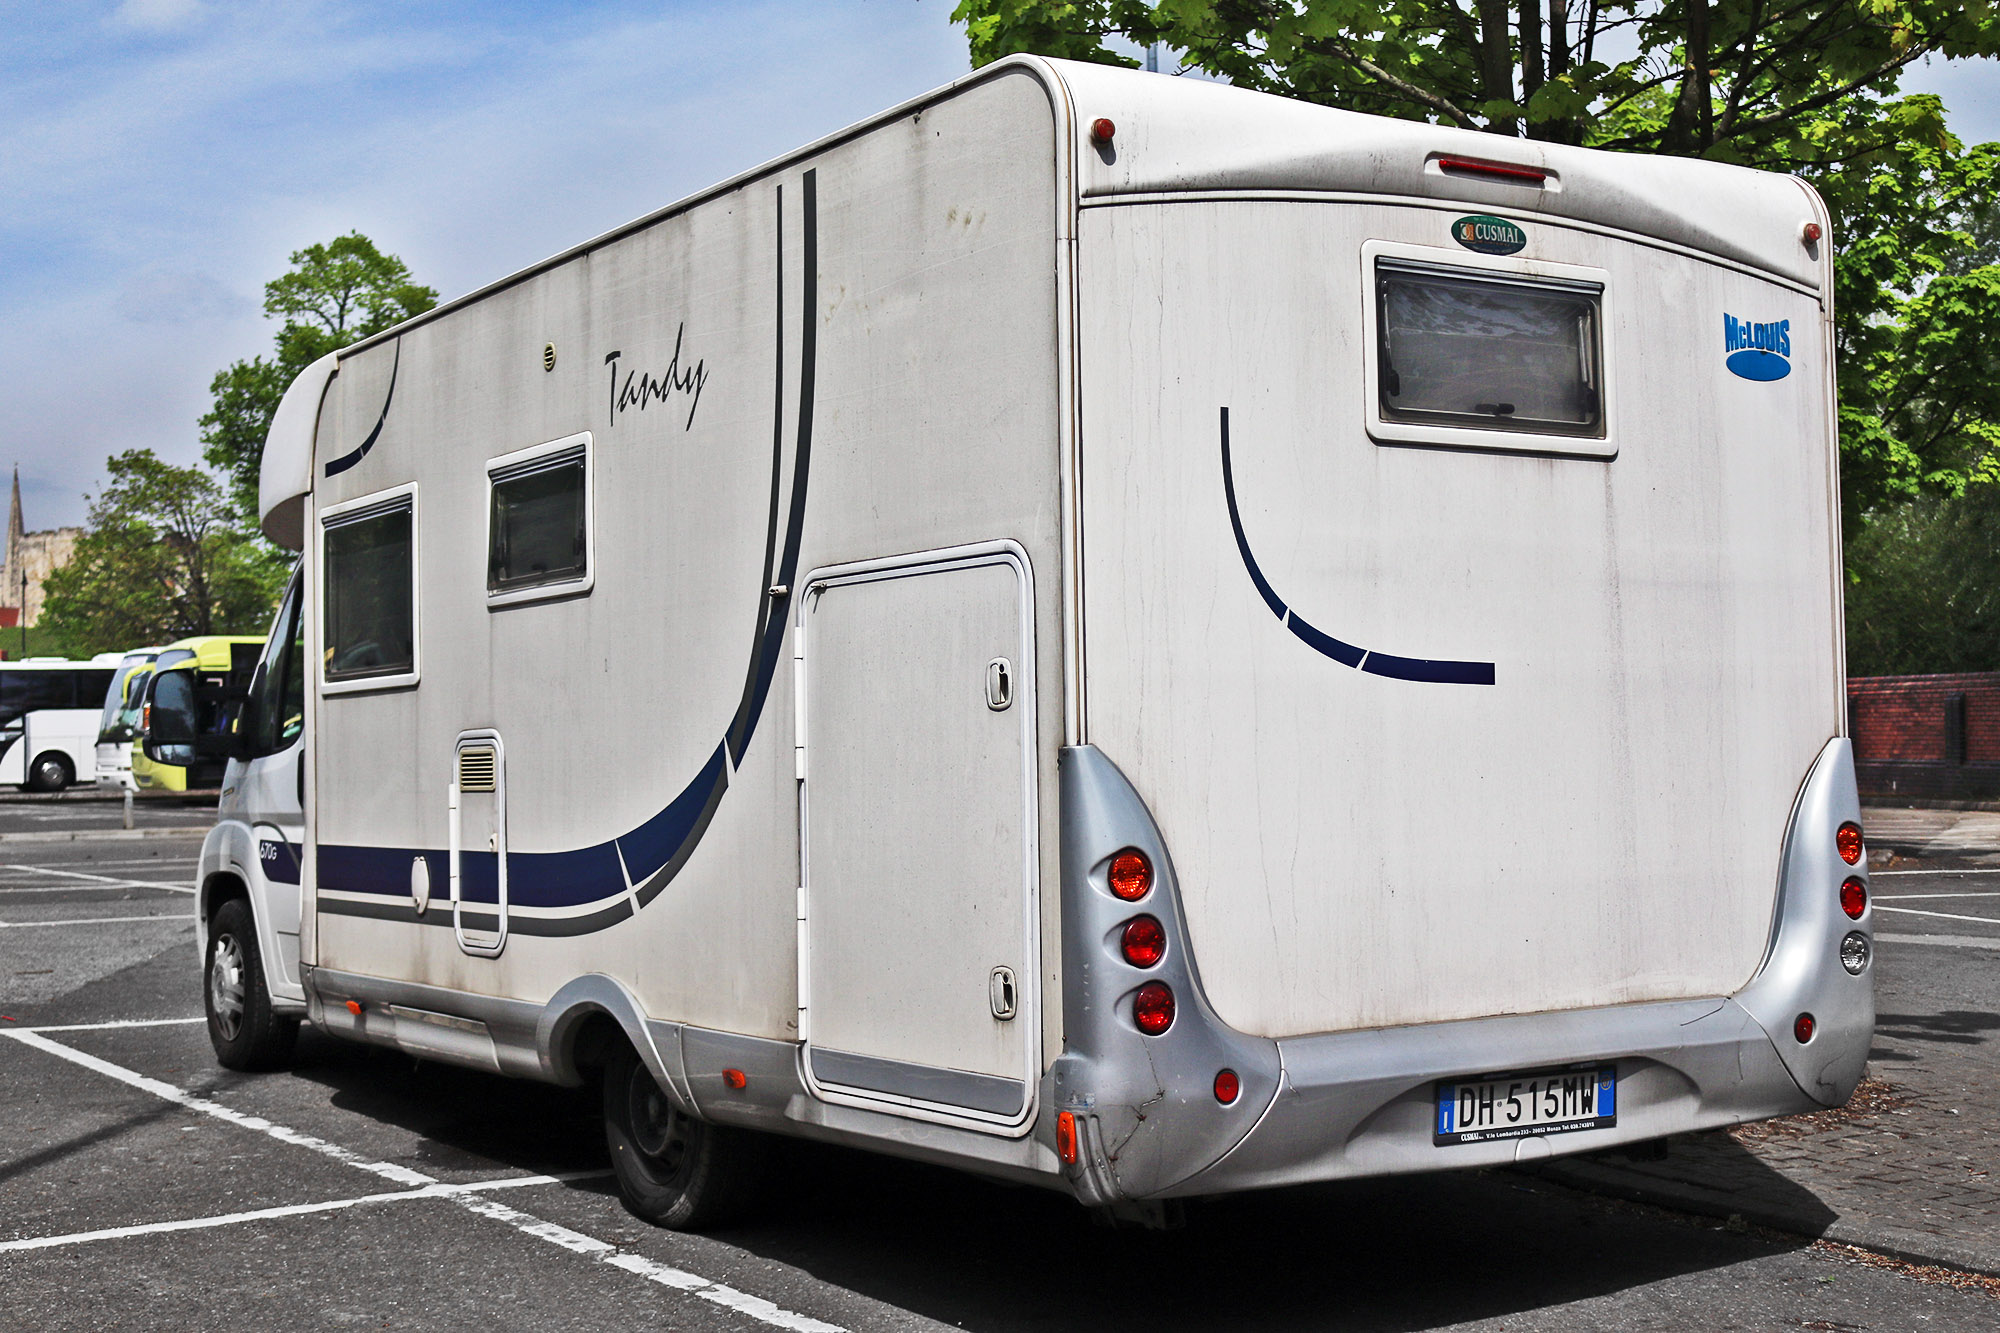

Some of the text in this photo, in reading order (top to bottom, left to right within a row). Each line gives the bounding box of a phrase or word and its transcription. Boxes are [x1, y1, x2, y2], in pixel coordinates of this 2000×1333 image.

[1475, 223, 1519, 243] CUSMAI
[604, 321, 710, 432] Tandy
[260, 842, 277, 861] 670G
[1459, 1075, 1595, 1128] DH 515MW
